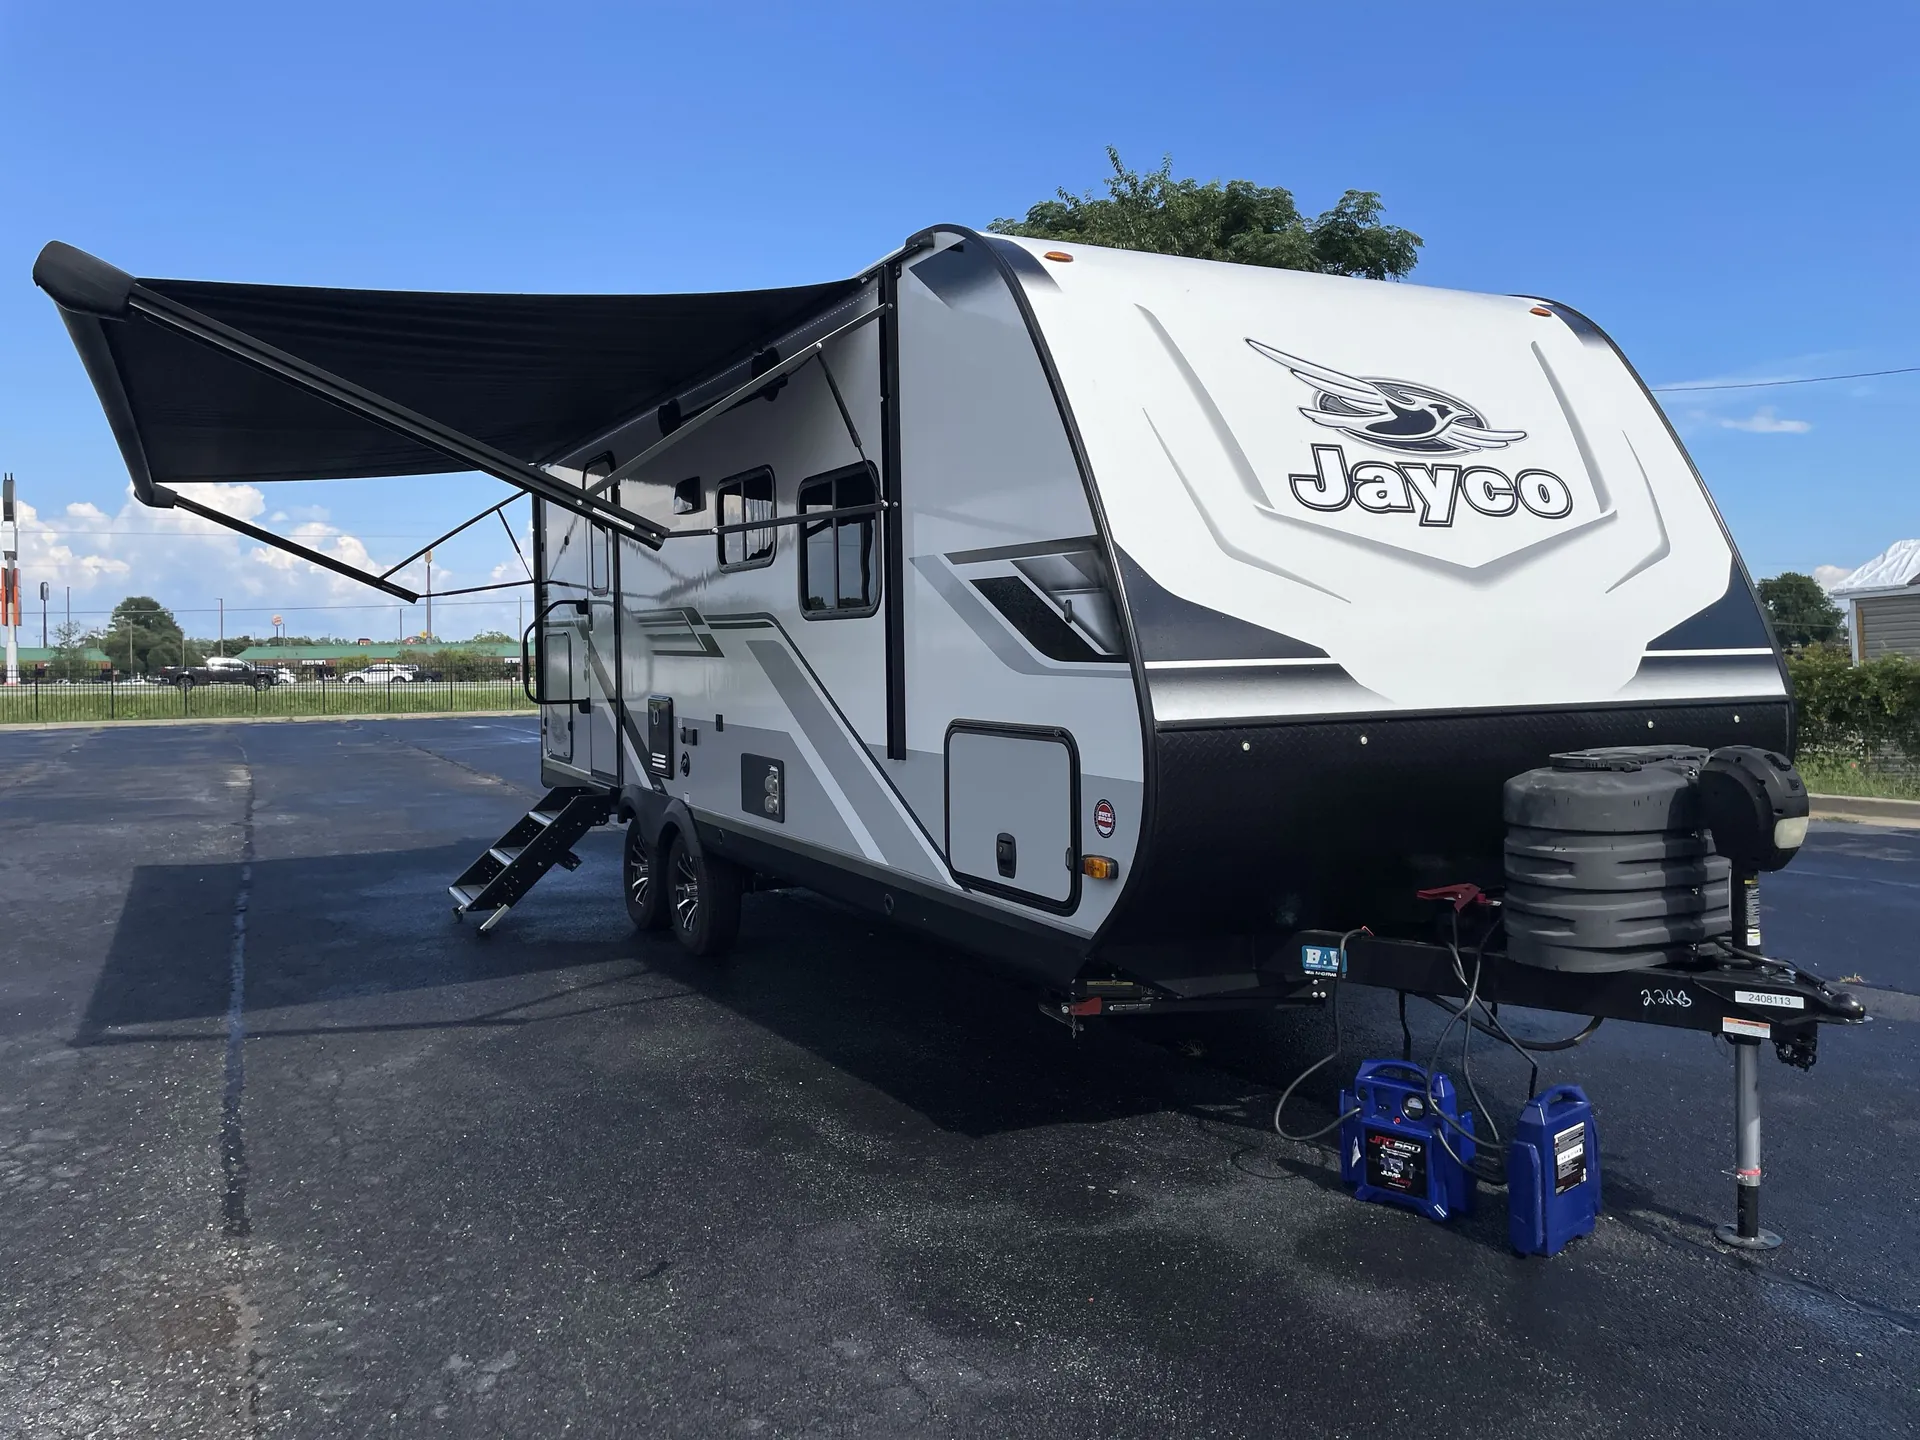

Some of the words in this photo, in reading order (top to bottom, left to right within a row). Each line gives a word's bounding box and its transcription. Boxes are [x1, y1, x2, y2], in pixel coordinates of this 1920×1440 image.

[1288, 443, 1573, 528] Jayco
[1305, 948, 1339, 967] BAL
[1748, 993, 1792, 1006] 2408113
